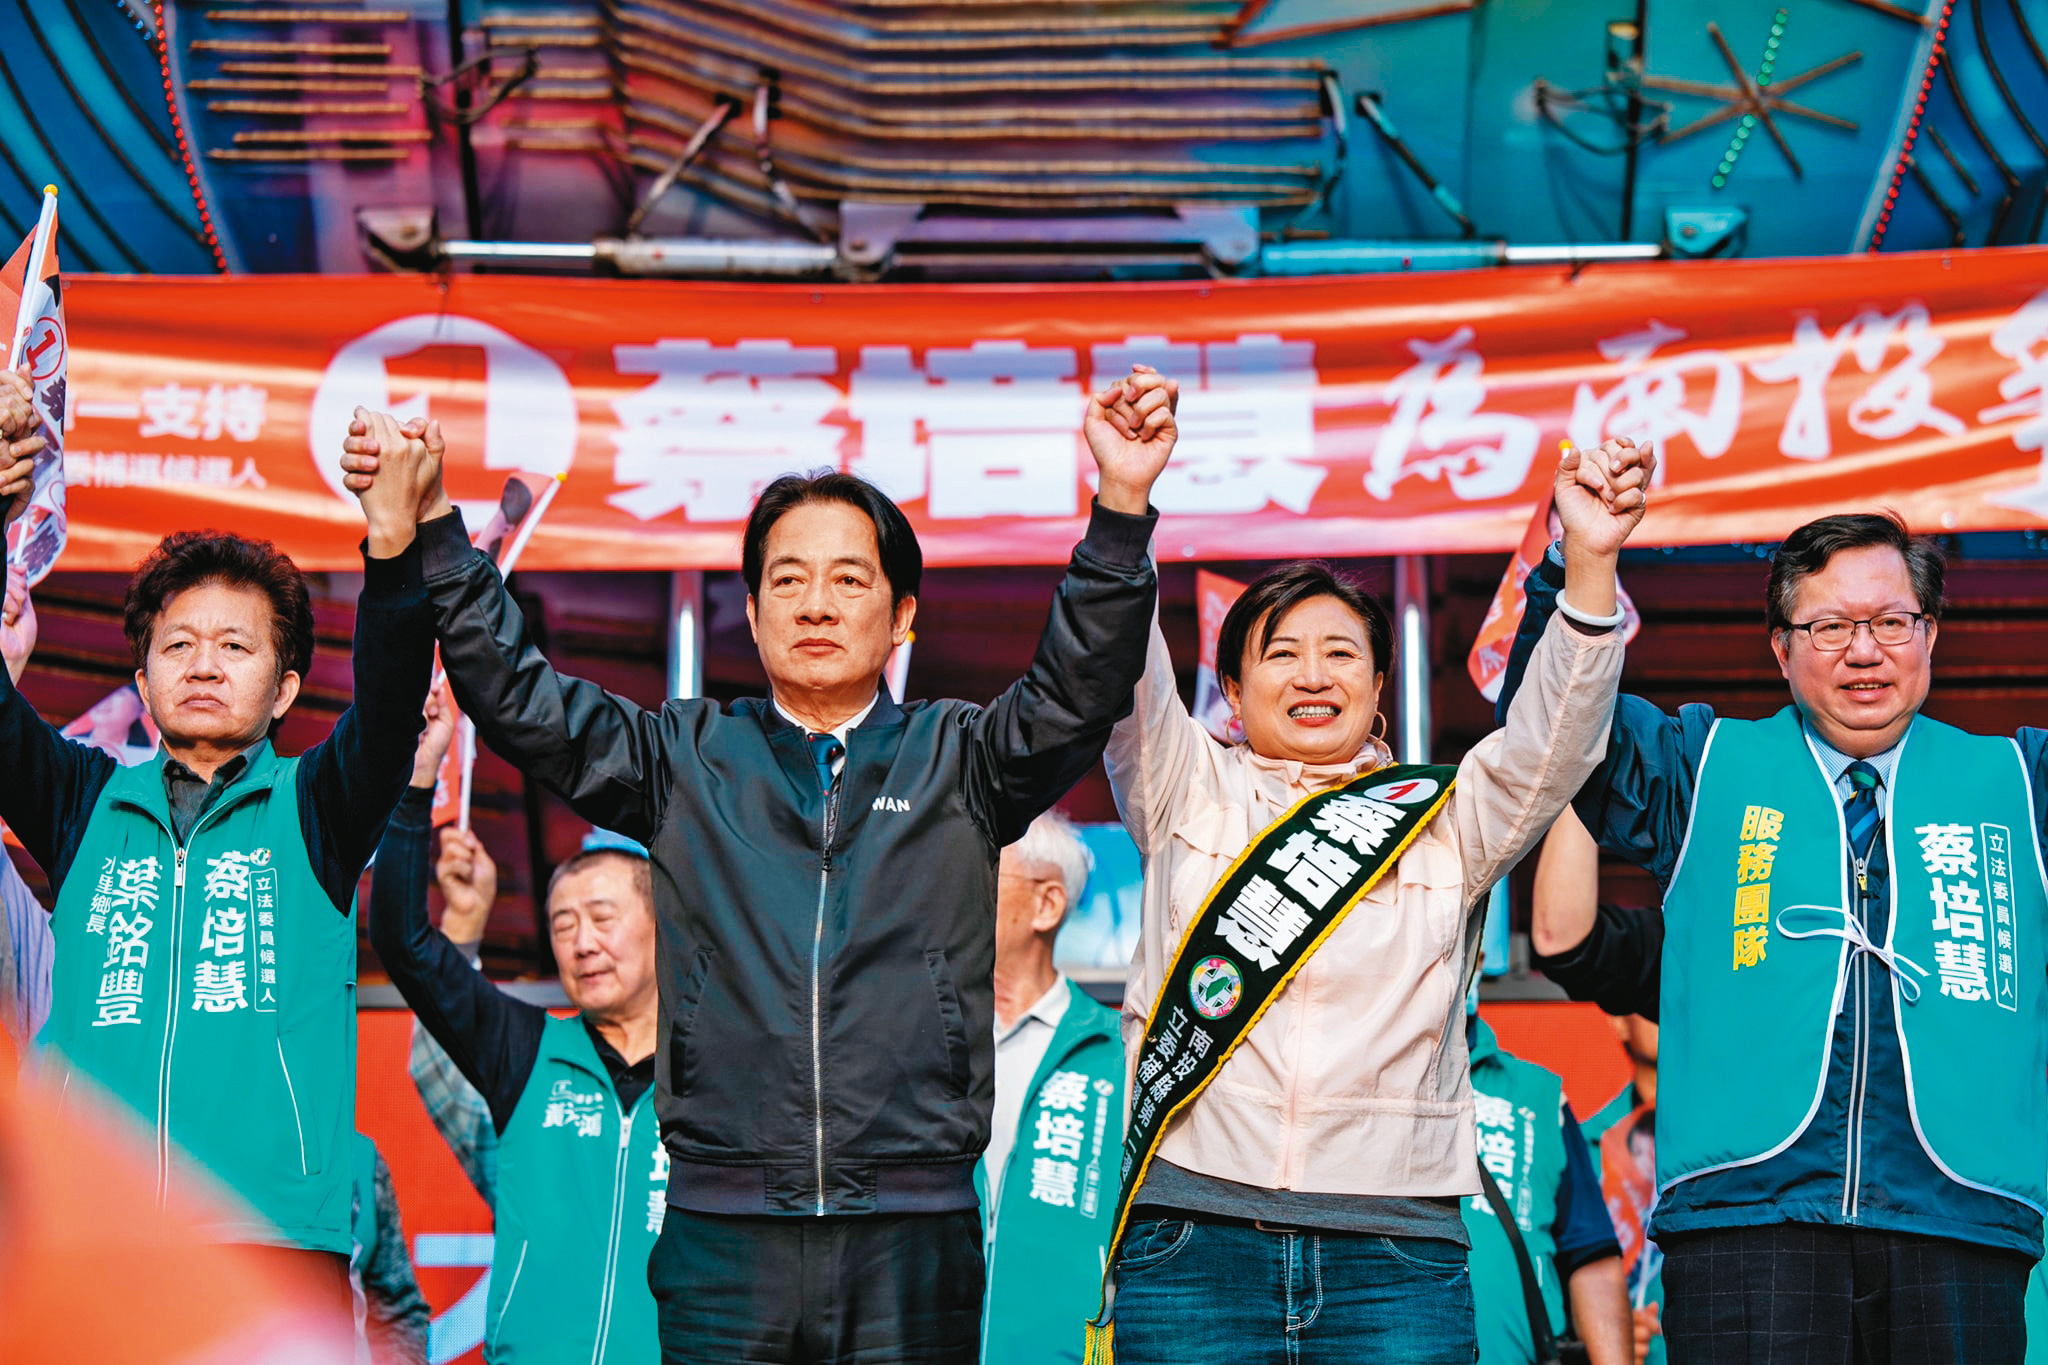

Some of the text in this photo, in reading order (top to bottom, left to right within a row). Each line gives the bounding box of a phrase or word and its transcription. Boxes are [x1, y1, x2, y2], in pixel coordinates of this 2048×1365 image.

[64, 382, 268, 442] 一支持
[612, 333, 1328, 522] 蔡培慧
[92, 856, 163, 1027] 葉銘豐
[191, 850, 251, 1012] 蔡培慧
[255, 876, 277, 1003] 立法委員候選人
[1214, 793, 1408, 973] 蔡培慧
[1733, 805, 1784, 971] 服務團隊
[1914, 823, 1992, 1002] 蔡培慧
[1989, 832, 2015, 1000] 立法委員候選人
[1029, 1070, 1089, 1208] 蔡培慧
